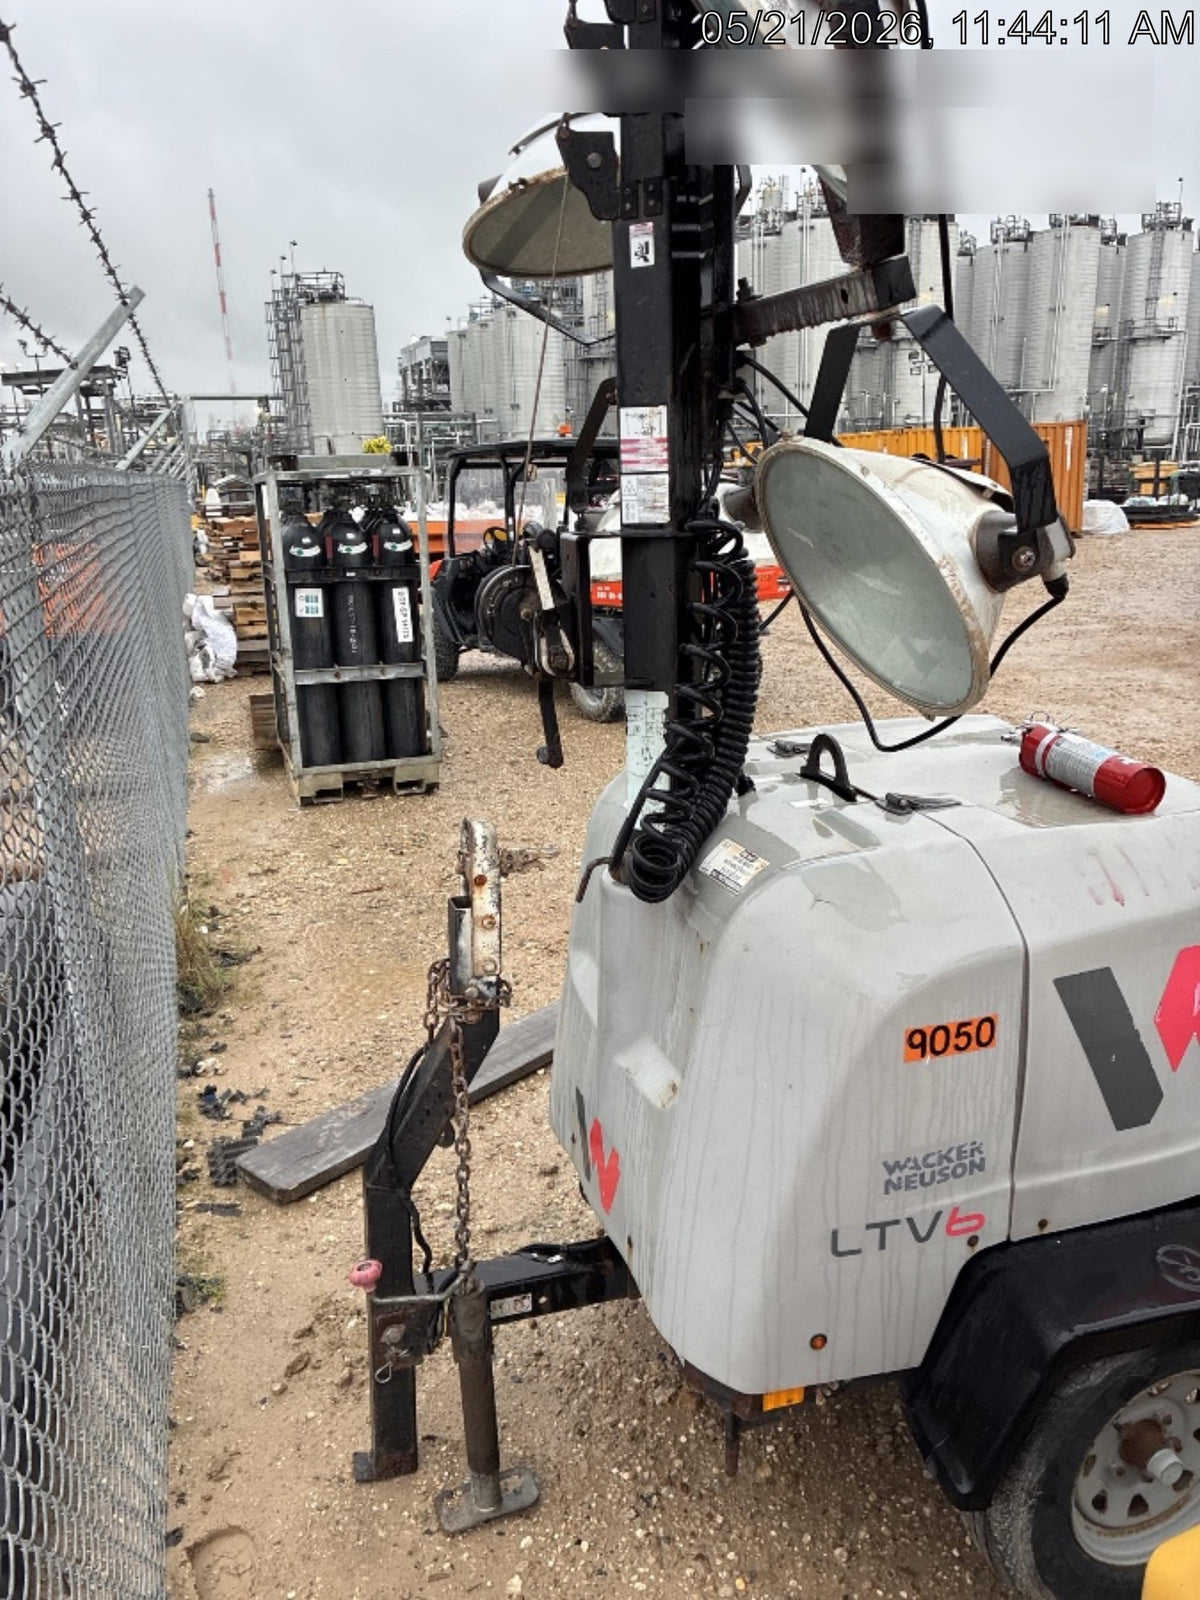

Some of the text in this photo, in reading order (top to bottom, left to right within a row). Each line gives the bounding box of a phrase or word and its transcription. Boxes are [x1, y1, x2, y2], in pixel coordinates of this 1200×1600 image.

[906, 1016, 996, 1059] 9050
[883, 1141, 985, 1176] WACKER
[883, 1156, 986, 1195] NEUSON
[831, 1206, 987, 1258] LTV6
